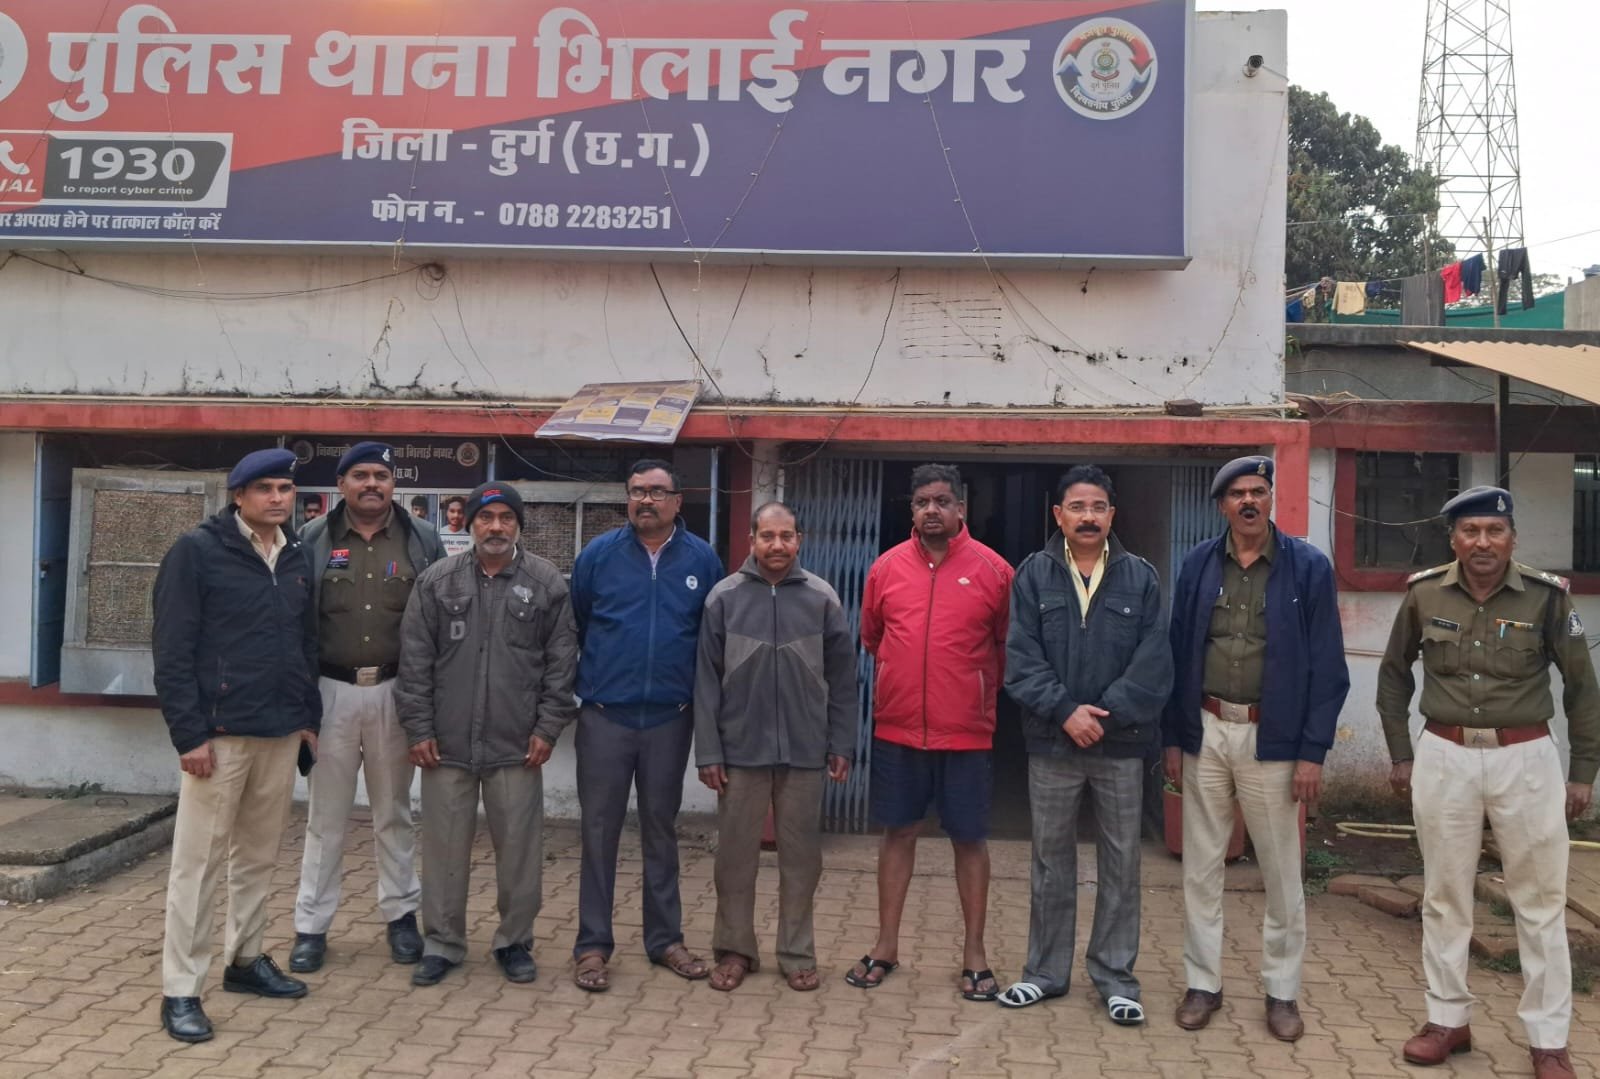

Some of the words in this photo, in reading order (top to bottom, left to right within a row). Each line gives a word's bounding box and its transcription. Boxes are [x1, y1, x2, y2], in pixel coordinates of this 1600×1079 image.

[48, 4, 291, 122] पुलिस
[308, 30, 516, 98] थाना
[533, 7, 810, 113] भिलाई
[821, 38, 1030, 104] नगर
[60, 146, 195, 182] 1930
[342, 117, 453, 161] जिला
[489, 118, 555, 177] दुर्ग
[563, 120, 710, 177] (छ.ग.)
[63, 184, 76, 193] to
[79, 185, 117, 194] report
[120, 185, 156, 195] cyber
[158, 185, 194, 195] crime
[13, 212, 61, 228] अपराध
[63, 209, 89, 228] होने
[92, 214, 111, 229] पर
[112, 213, 161, 230] तत्काल
[163, 211, 197, 231] कॉल
[371, 193, 429, 222] फोन
[433, 201, 464, 224] न.
[500, 202, 560, 228] 0788
[566, 205, 671, 230] 2283251
